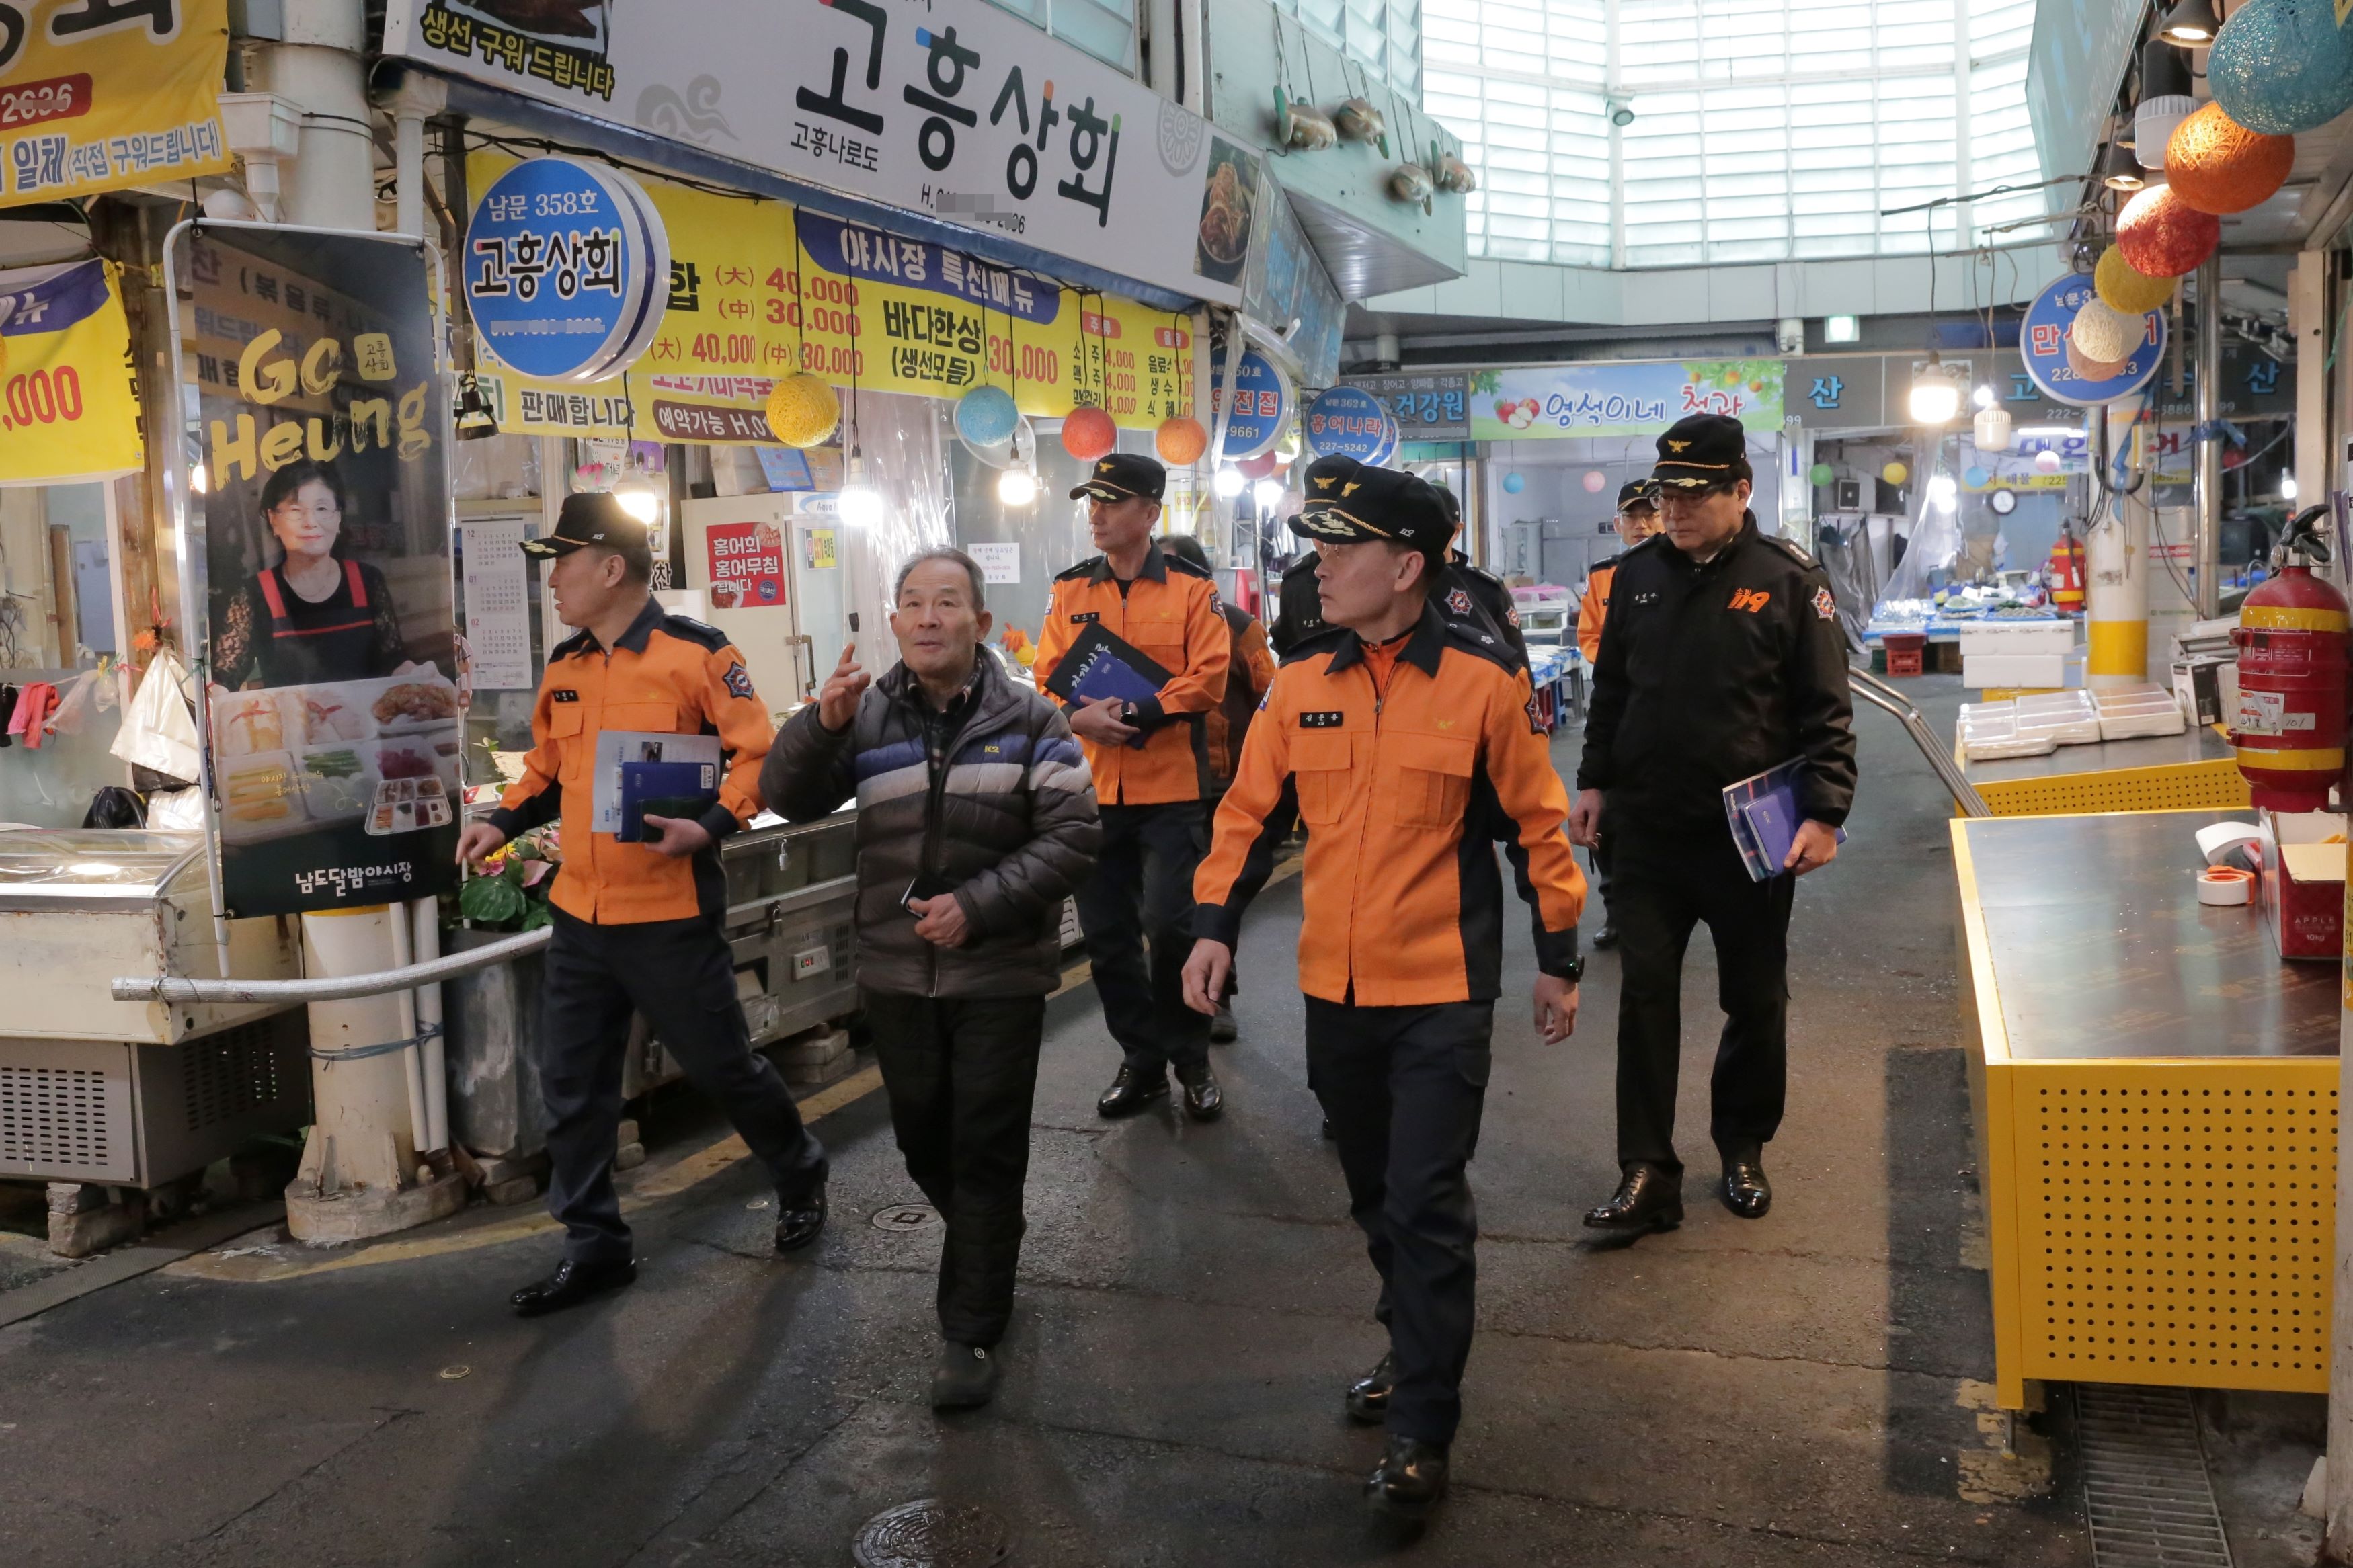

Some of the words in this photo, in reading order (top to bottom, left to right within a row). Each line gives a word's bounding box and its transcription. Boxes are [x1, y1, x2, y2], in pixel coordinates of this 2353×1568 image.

[424, 8, 471, 53] 생선
[480, 28, 524, 70] 구워
[530, 46, 614, 101] 드립니다
[795, 0, 1122, 229] 고흥상회
[13, 136, 66, 190] 일체
[112, 120, 221, 172] 구워드립니다)
[790, 122, 879, 173] 고흥나로도
[489, 197, 526, 222] 남문
[536, 189, 598, 218] 358호
[473, 229, 621, 300] 고흥상회
[840, 226, 926, 282] 야시장
[941, 244, 1035, 314] 특선메뉴
[766, 267, 859, 307] 40,000
[766, 298, 861, 337] 30,000
[883, 300, 981, 356] 바다한상
[692, 333, 755, 366] 40,000
[802, 342, 863, 377] 30,000
[891, 345, 976, 388] (생선모듬)
[989, 334, 1058, 385] 30,000
[521, 390, 636, 428] 판매합니다
[659, 407, 725, 436] 예약가능
[1546, 392, 1667, 427] 영석이네
[1319, 441, 1368, 453] 227-5242
[713, 536, 761, 556] 홍어회
[715, 556, 779, 578] 홍어무침
[717, 579, 752, 593] 됩니다
[984, 745, 1000, 753] K2
[295, 861, 412, 897] 남도달밤야시장
[2295, 917, 2335, 925] APPLE
